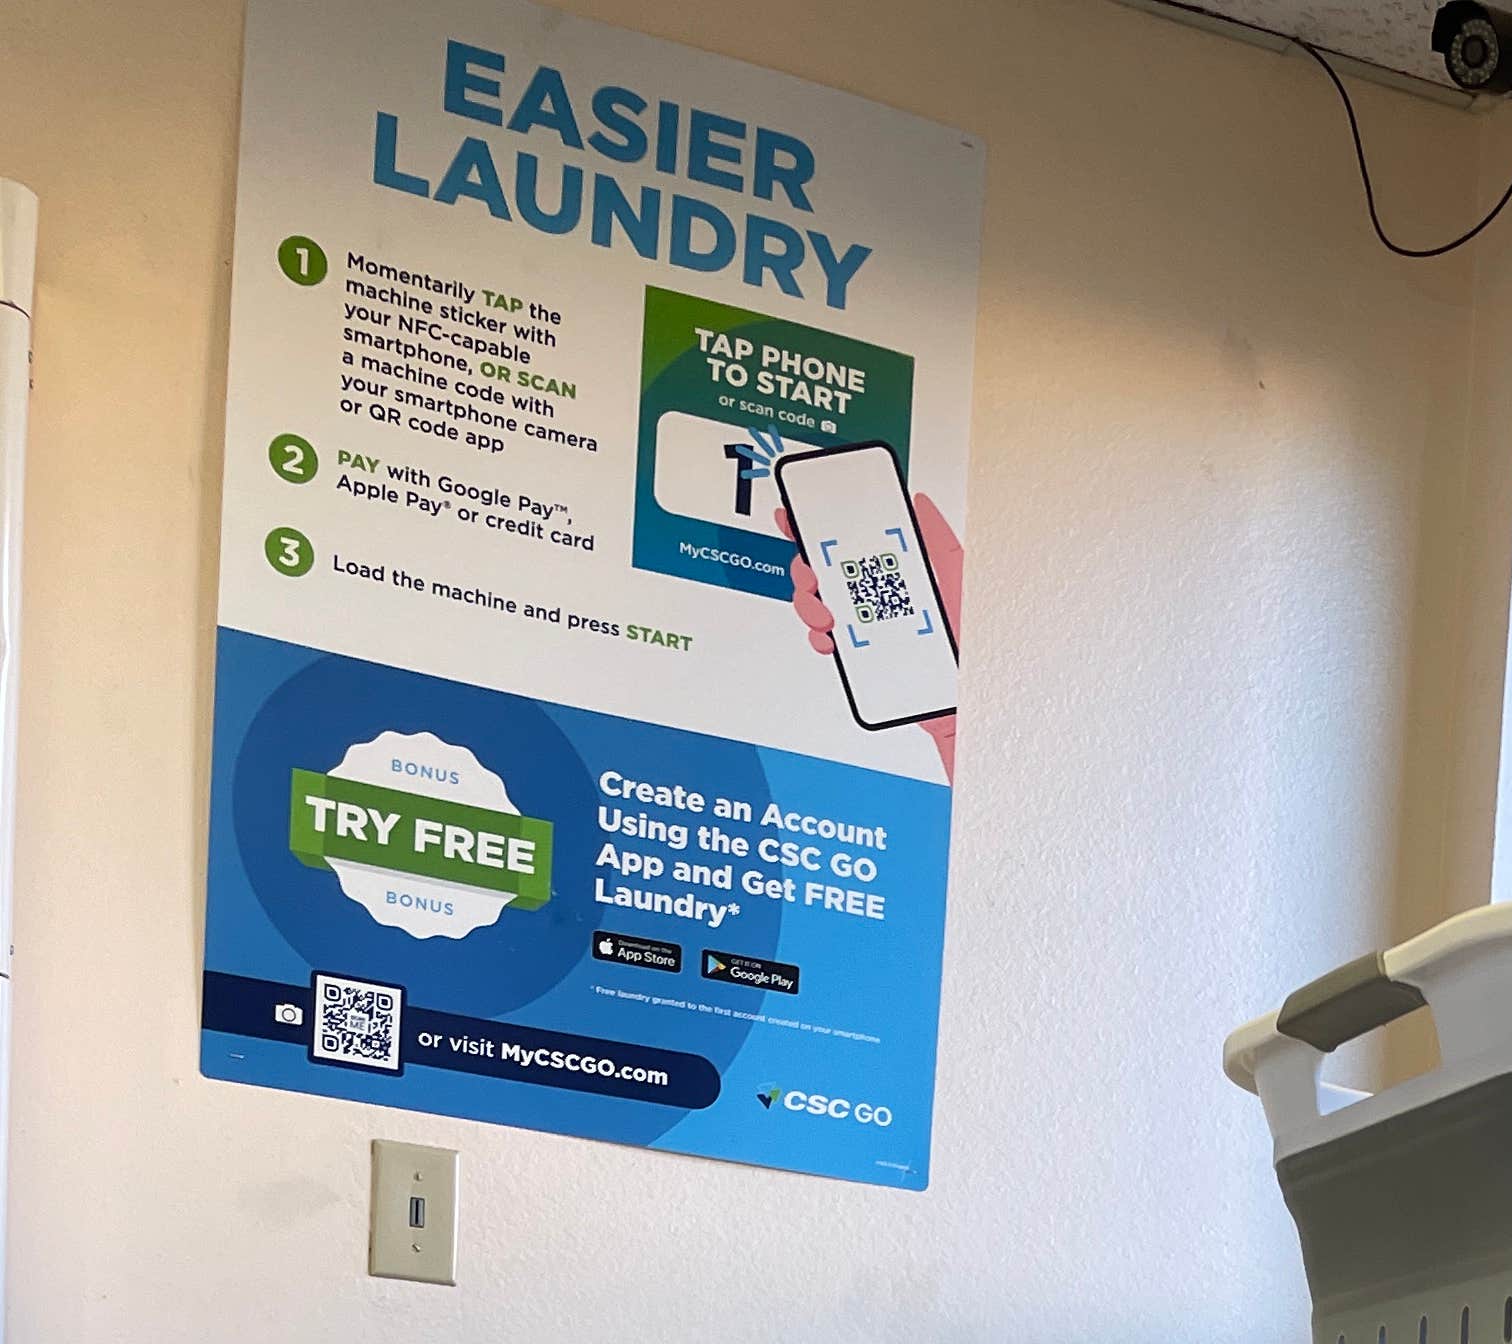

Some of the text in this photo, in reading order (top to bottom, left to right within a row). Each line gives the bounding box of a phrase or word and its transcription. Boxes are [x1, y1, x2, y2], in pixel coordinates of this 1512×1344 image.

[444, 38, 815, 213] EASIER
[373, 110, 873, 310] LAUNDRY
[296, 247, 310, 276] 1
[347, 251, 562, 325] Momentarily TAP the
[344, 303, 531, 364] your NFC-capable
[346, 279, 556, 347] machine sticker with
[342, 352, 555, 418] a machine code with
[344, 326, 577, 399] smartphone, OR SCAN
[695, 328, 865, 393] TAP PHONE
[706, 357, 853, 414] TO START
[340, 400, 504, 454] or QR code app
[341, 375, 598, 452] your smartphone camera
[718, 395, 816, 429] or scan code
[283, 445, 304, 474] 2
[338, 450, 380, 474] PAY
[386, 463, 431, 489] with
[438, 476, 511, 508] Google
[337, 474, 399, 504] Apple
[457, 506, 479, 523] or
[485, 512, 544, 541] credit
[550, 525, 595, 552] card
[278, 537, 300, 568] 3
[679, 541, 786, 577] MyCSCGO.com
[333, 554, 692, 652] Load the machine and press START
[391, 758, 460, 786] BONUS
[304, 795, 536, 875] TRY FREE
[599, 770, 888, 851] Create an Account
[598, 805, 877, 883] Using the CSC GO
[386, 890, 454, 916] BONUS
[595, 843, 885, 920] App and Get FREE
[617, 947, 676, 967] App Store
[730, 966, 794, 990] Google Play
[596, 986, 616, 996] Free
[617, 989, 650, 1003] laundry
[652, 997, 685, 1008] granted
[699, 1004, 713, 1014] the
[714, 1007, 731, 1016] first
[733, 1011, 765, 1022] account
[768, 1016, 799, 1028] created
[813, 1026, 831, 1034] your
[833, 1029, 880, 1044] smartphone
[418, 1031, 668, 1086] or visit MyCSCGO.com
[784, 1090, 892, 1126] CSC GO
